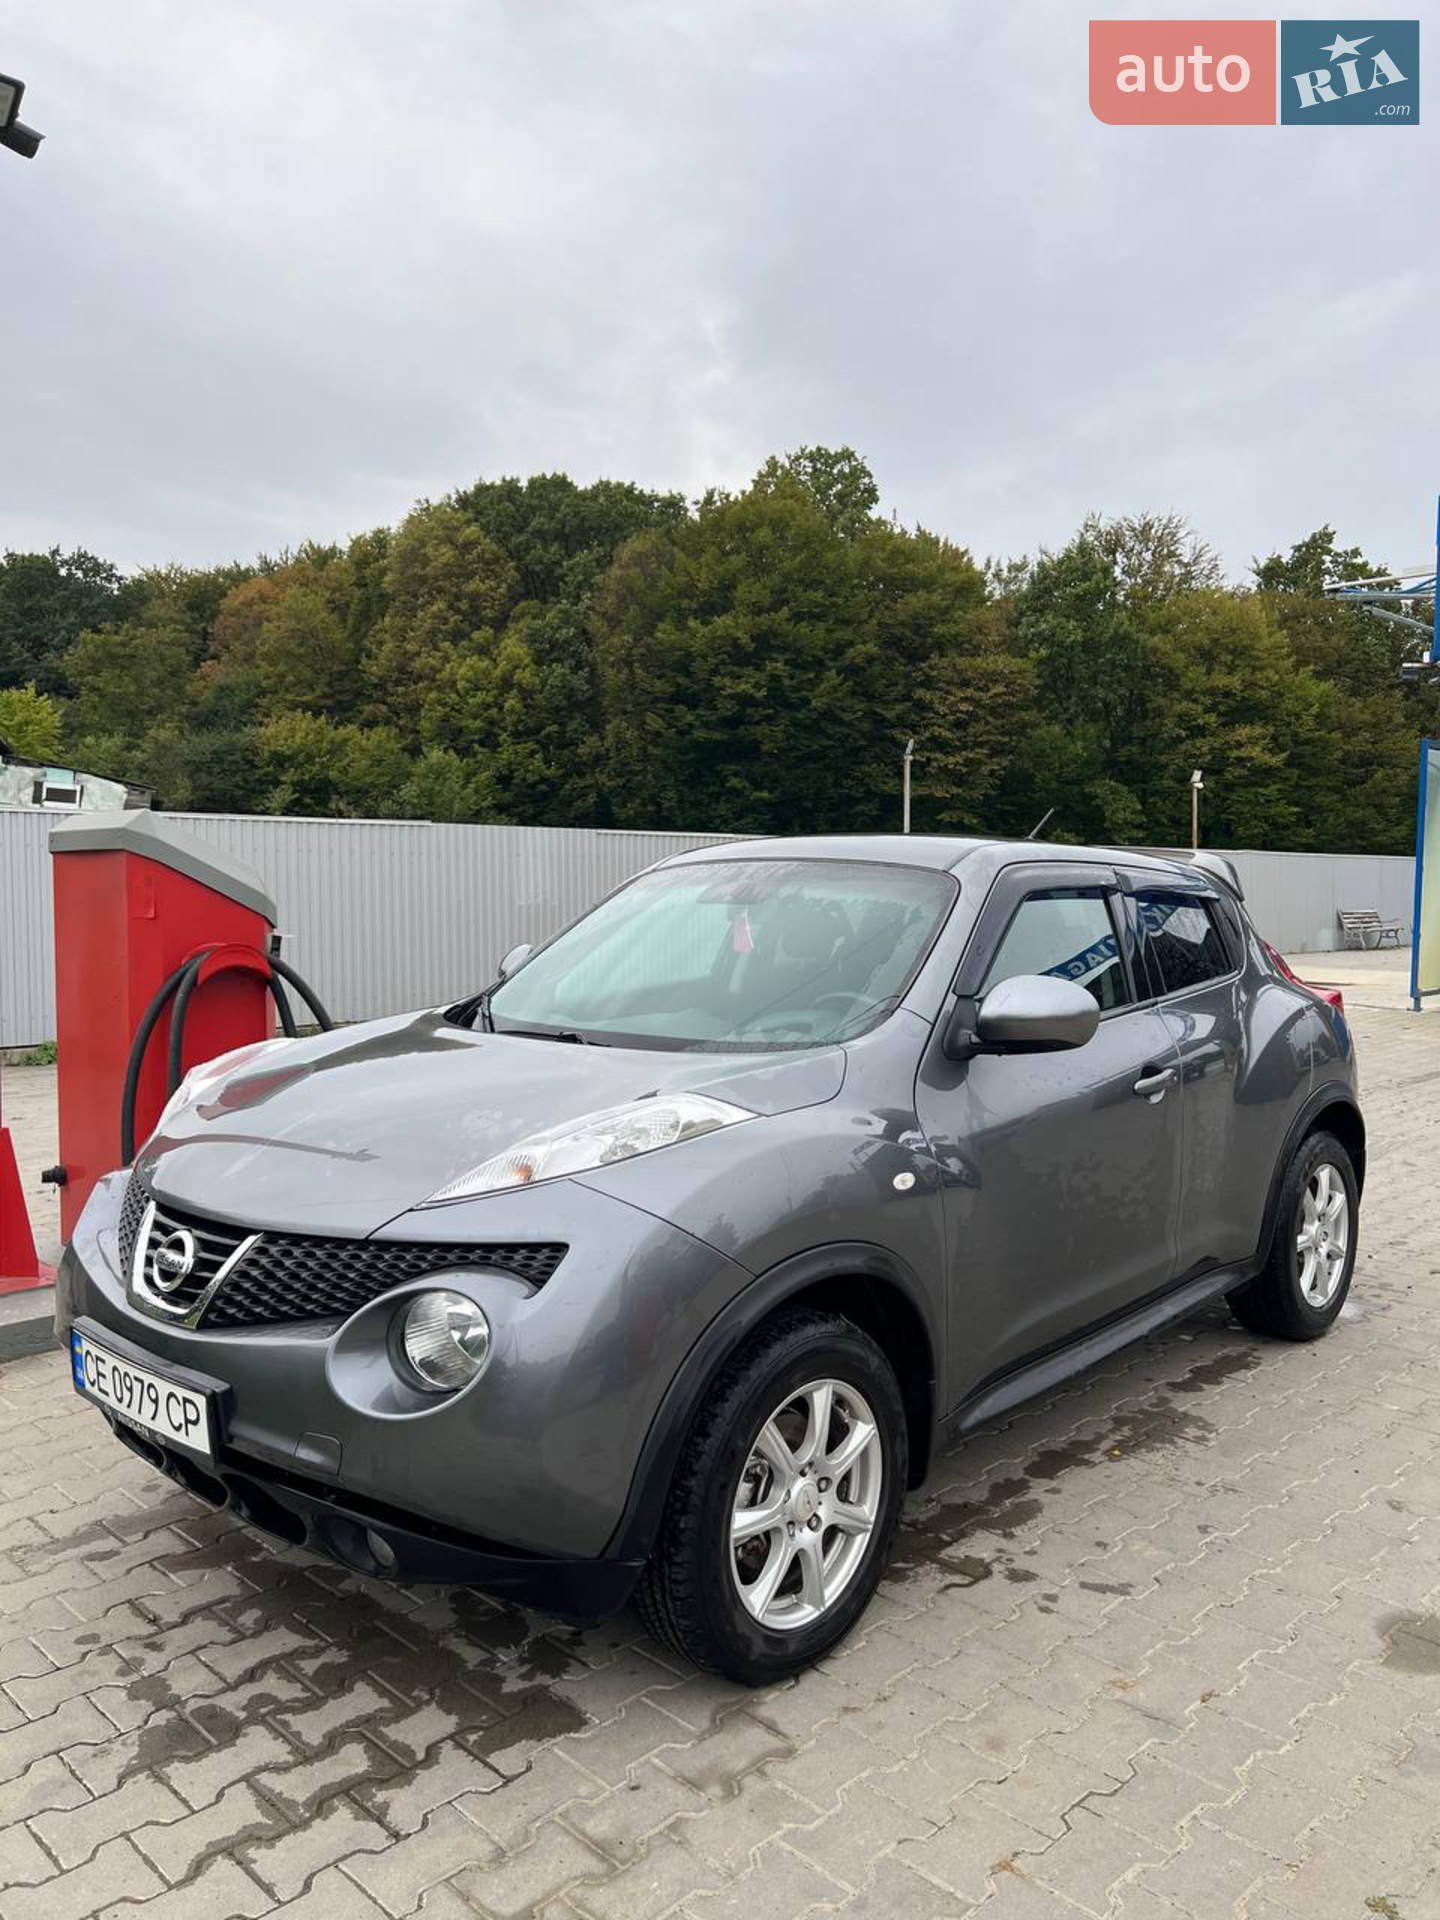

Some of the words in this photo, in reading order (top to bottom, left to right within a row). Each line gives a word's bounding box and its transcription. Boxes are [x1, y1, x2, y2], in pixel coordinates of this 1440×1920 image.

[84, 1349, 110, 1398] CE
[112, 1364, 159, 1421] 0979
[165, 1391, 201, 1437] CP
